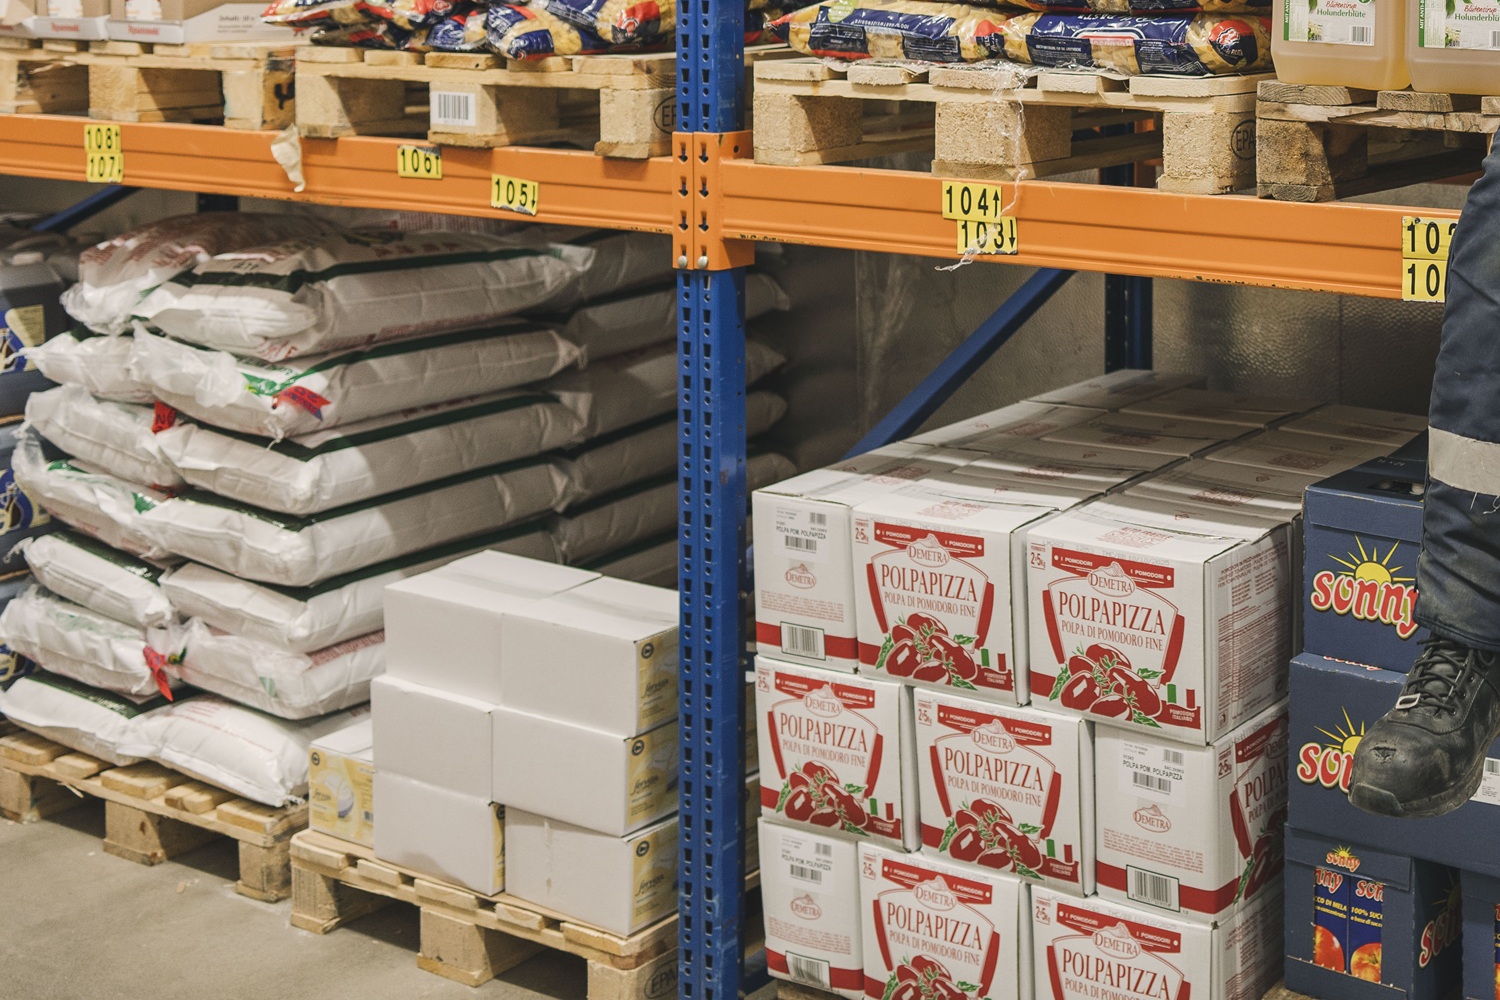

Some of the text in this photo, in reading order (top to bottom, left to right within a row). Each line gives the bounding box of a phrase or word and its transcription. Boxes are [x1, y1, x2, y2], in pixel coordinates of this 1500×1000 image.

[1316, 9, 1366, 18] Holunderblüte
[87, 127, 113, 149] 108
[90, 156, 115, 177] 107
[401, 148, 432, 174] 106
[495, 178, 528, 207] 105
[946, 185, 989, 216] 104
[961, 220, 1005, 249] 103
[1408, 221, 1458, 255] 10
[1408, 264, 1440, 297] 10
[885, 530, 911, 540] POMODORI
[949, 540, 975, 550] POMODORI
[908, 545, 949, 563] DEMETRA
[1065, 556, 1093, 566] POMODORI
[785, 572, 816, 588] DEMETRA
[881, 563, 978, 603] POLPAPIZZA
[1090, 572, 1134, 594] DEMETRA
[1136, 569, 1164, 579] POMODORI
[884, 592, 976, 618] POLPA DI POMODORO FINE
[1059, 591, 1167, 636] POLPAPIZZA
[1061, 619, 1164, 652] POLPA DI POMODORO FINE
[805, 695, 841, 714] DEMETRA
[780, 712, 868, 753] POLPAPIZZA
[972, 733, 1014, 751] DEMETRA
[944, 747, 1044, 792] POLPAPIZZA
[947, 777, 1042, 808] POLPA DI POMODORO FINE
[1133, 812, 1171, 832] DEMETRA
[915, 886, 956, 907] DEMETRA
[1355, 880, 1384, 902] son
[1324, 898, 1347, 912] DI MELA
[1351, 906, 1368, 917] 100%
[887, 902, 983, 951] POLPAPIZZA
[889, 930, 980, 967] POLPA DI POMODORO FINE
[1094, 932, 1139, 955] DEMETRA
[650, 959, 679, 992] EPA
[1062, 948, 1171, 1000] POLPAPIZZA
